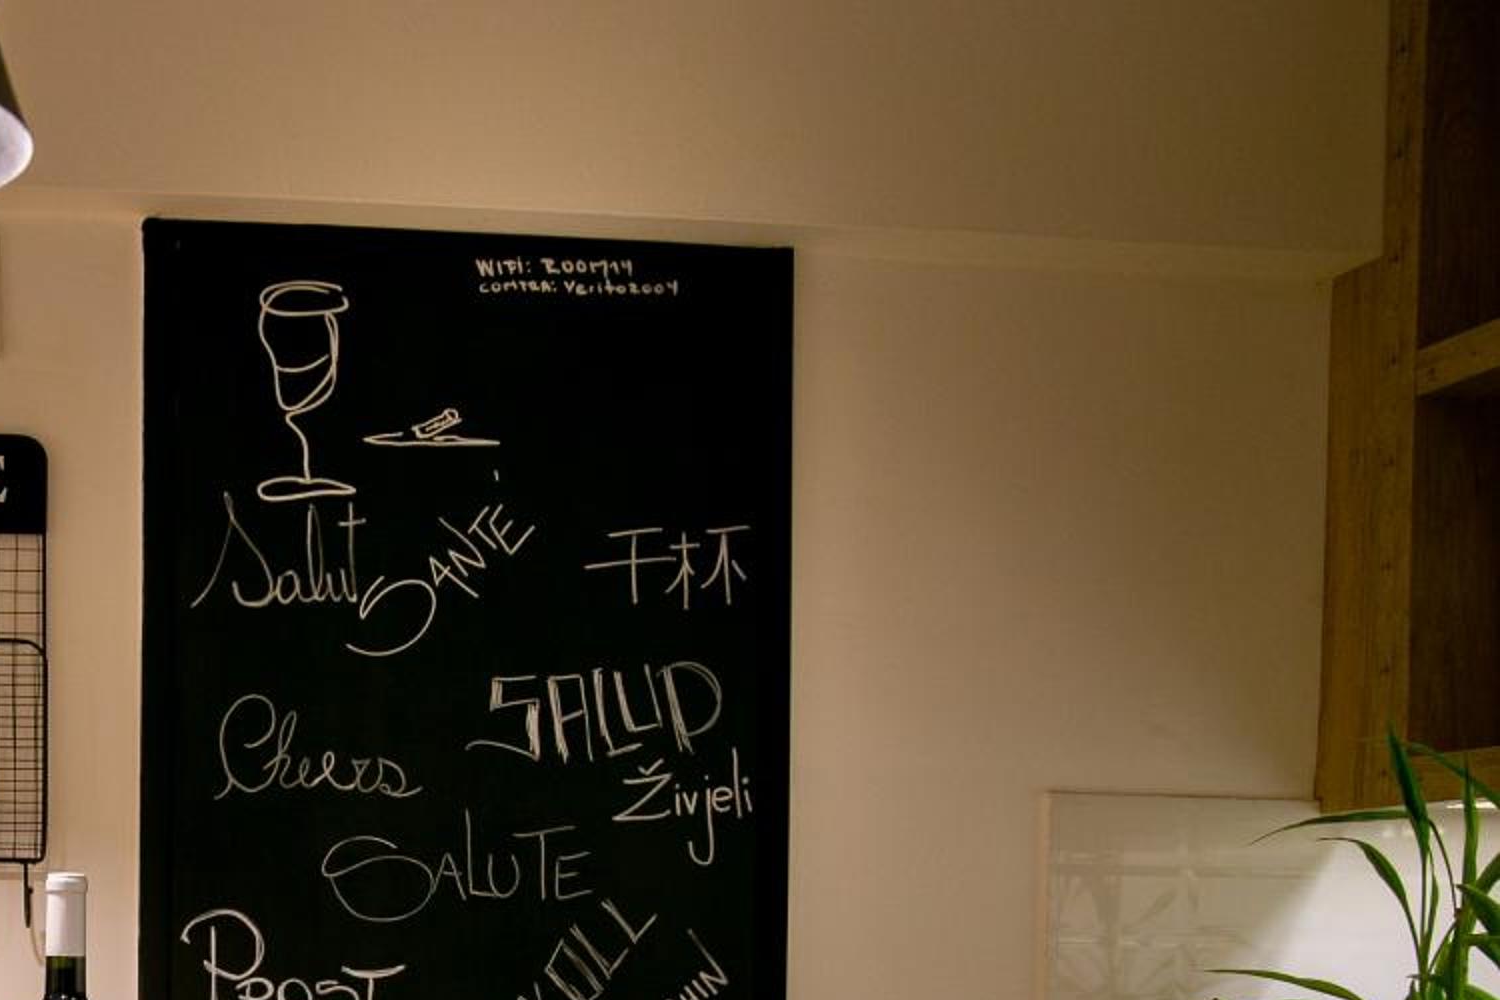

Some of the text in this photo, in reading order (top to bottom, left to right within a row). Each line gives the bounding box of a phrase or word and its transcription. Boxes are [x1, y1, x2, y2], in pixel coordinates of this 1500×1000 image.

[190, 490, 368, 609] Salut
[213, 693, 424, 800] Cheers
[464, 660, 723, 764] SALUD
[611, 746, 753, 866] Živjeli
[321, 808, 594, 923] SALUTE
